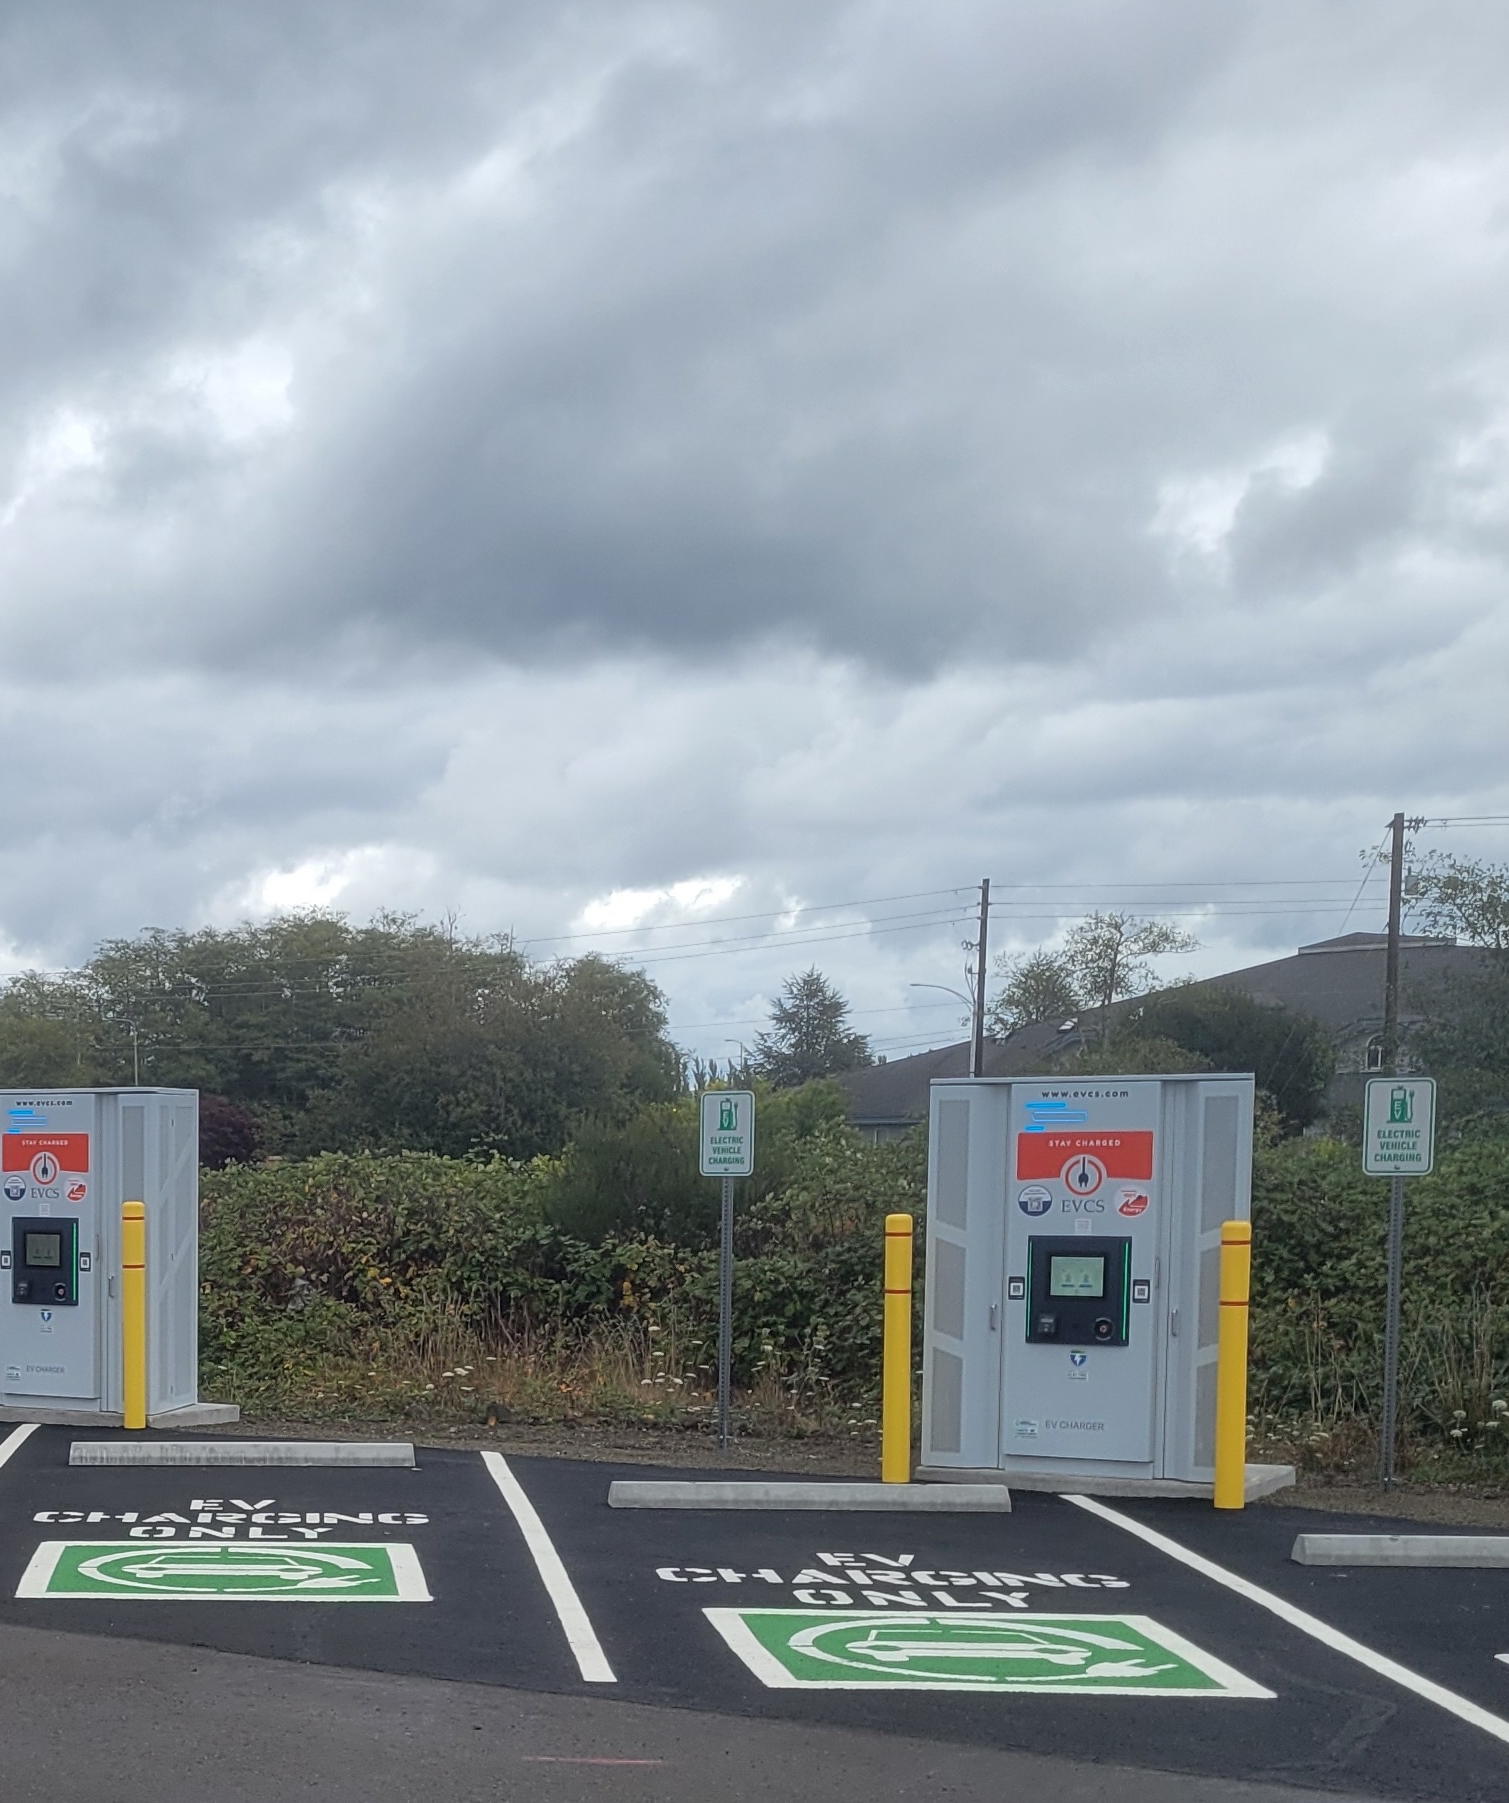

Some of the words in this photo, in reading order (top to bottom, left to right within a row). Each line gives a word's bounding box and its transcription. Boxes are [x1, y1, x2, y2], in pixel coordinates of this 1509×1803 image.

[1041, 1090, 1129, 1098] www.evcs.com
[1394, 1101, 1402, 1120] EV
[722, 1111, 729, 1128] EV
[710, 1136, 744, 1144] ELECTRIC
[1377, 1130, 1421, 1139] ELECTRIC
[1048, 1139, 1071, 1147] STAY
[1075, 1139, 1121, 1147] CHARGED
[1379, 1141, 1417, 1150] VEHICLE
[712, 1146, 741, 1154] VEHICLE
[708, 1157, 745, 1165] CHARGING
[1374, 1153, 1422, 1162] CHARGING
[31, 1187, 60, 1199] EVCS
[1061, 1199, 1105, 1213] EVCS
[1045, 1420, 1058, 1429] EV
[1059, 1421, 1105, 1431] CHARGER
[190, 1499, 276, 1511] EV
[32, 1511, 430, 1526] CHARGING
[128, 1526, 333, 1540] ONLY
[815, 1552, 915, 1567] EV
[655, 1567, 1131, 1588] CHARGING
[792, 1588, 1030, 1609] ONLY
